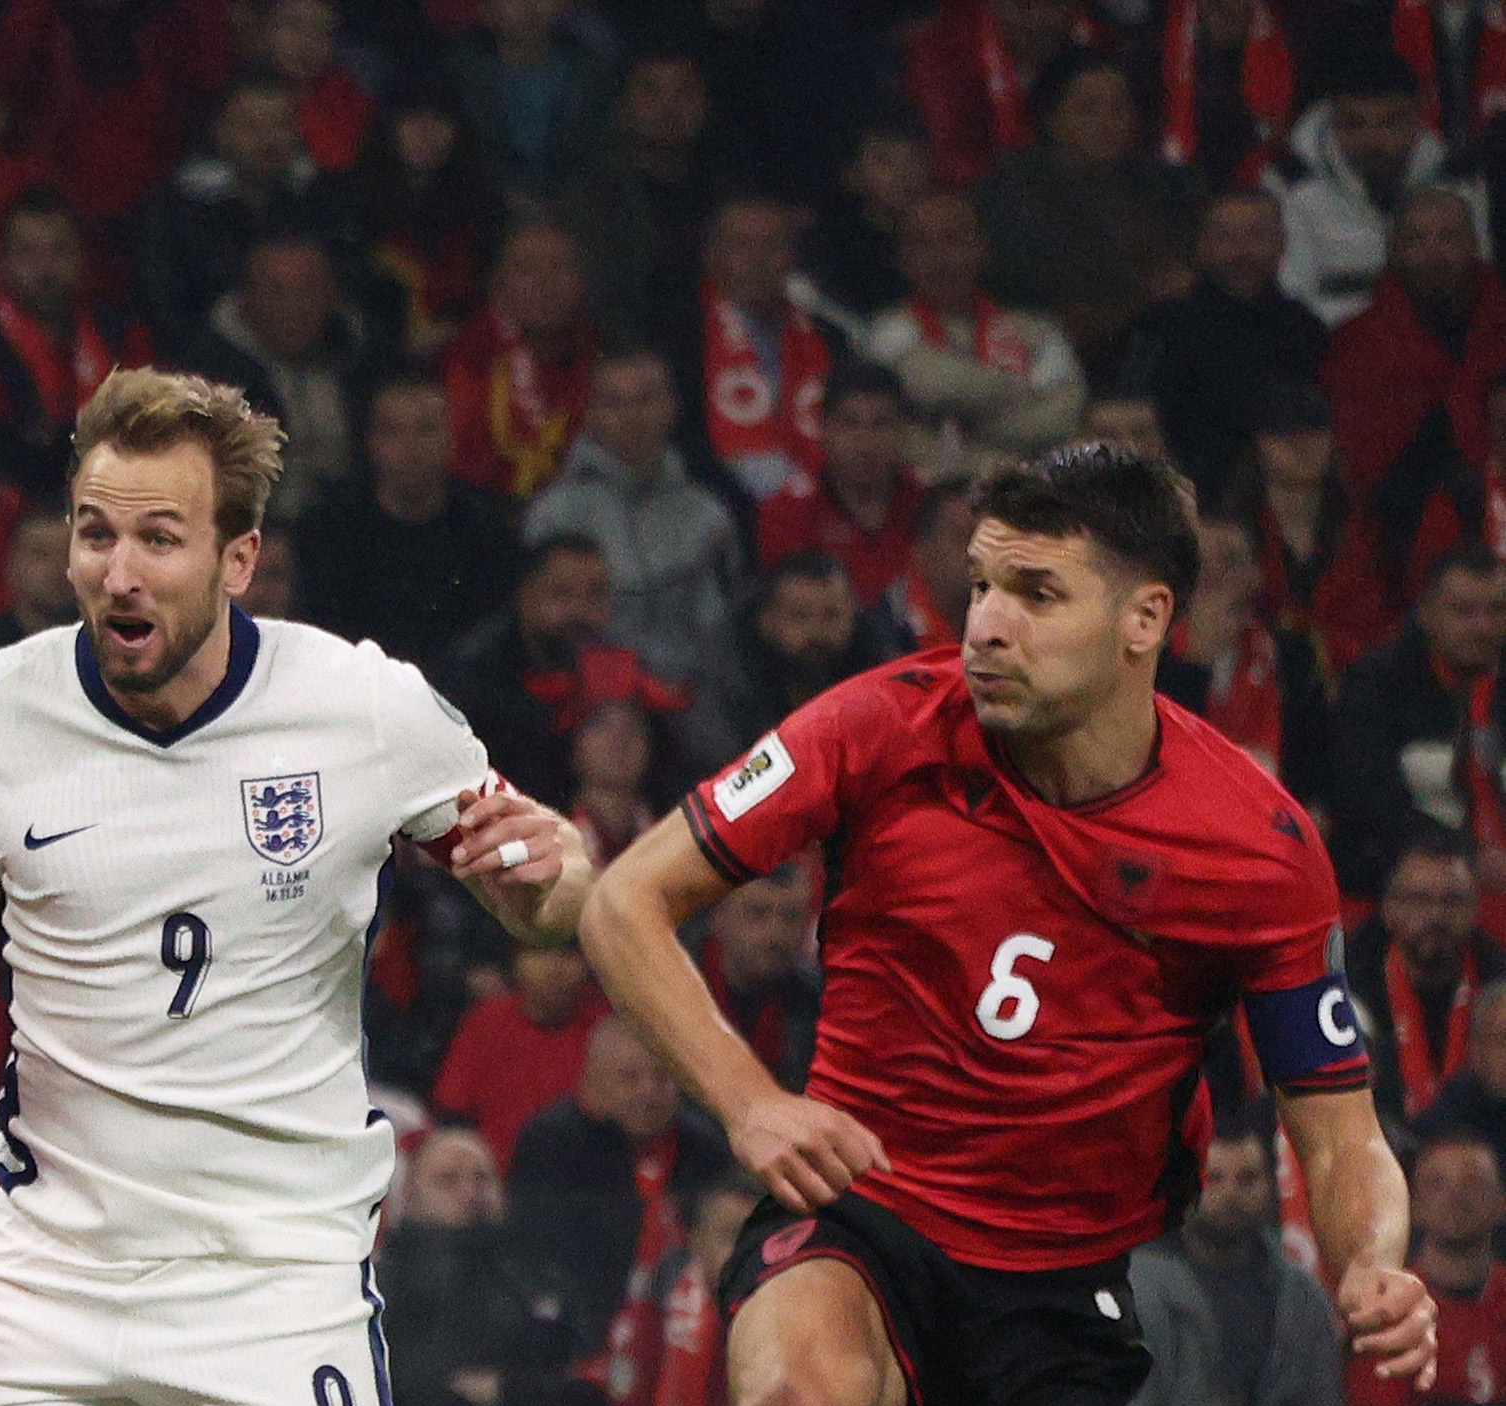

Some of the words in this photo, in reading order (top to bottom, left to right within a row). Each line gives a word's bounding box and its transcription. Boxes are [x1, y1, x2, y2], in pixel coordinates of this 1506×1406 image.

[161, 912, 212, 1019] 9
[975, 932, 1055, 1041] 6
[1317, 987, 1357, 1047] C
